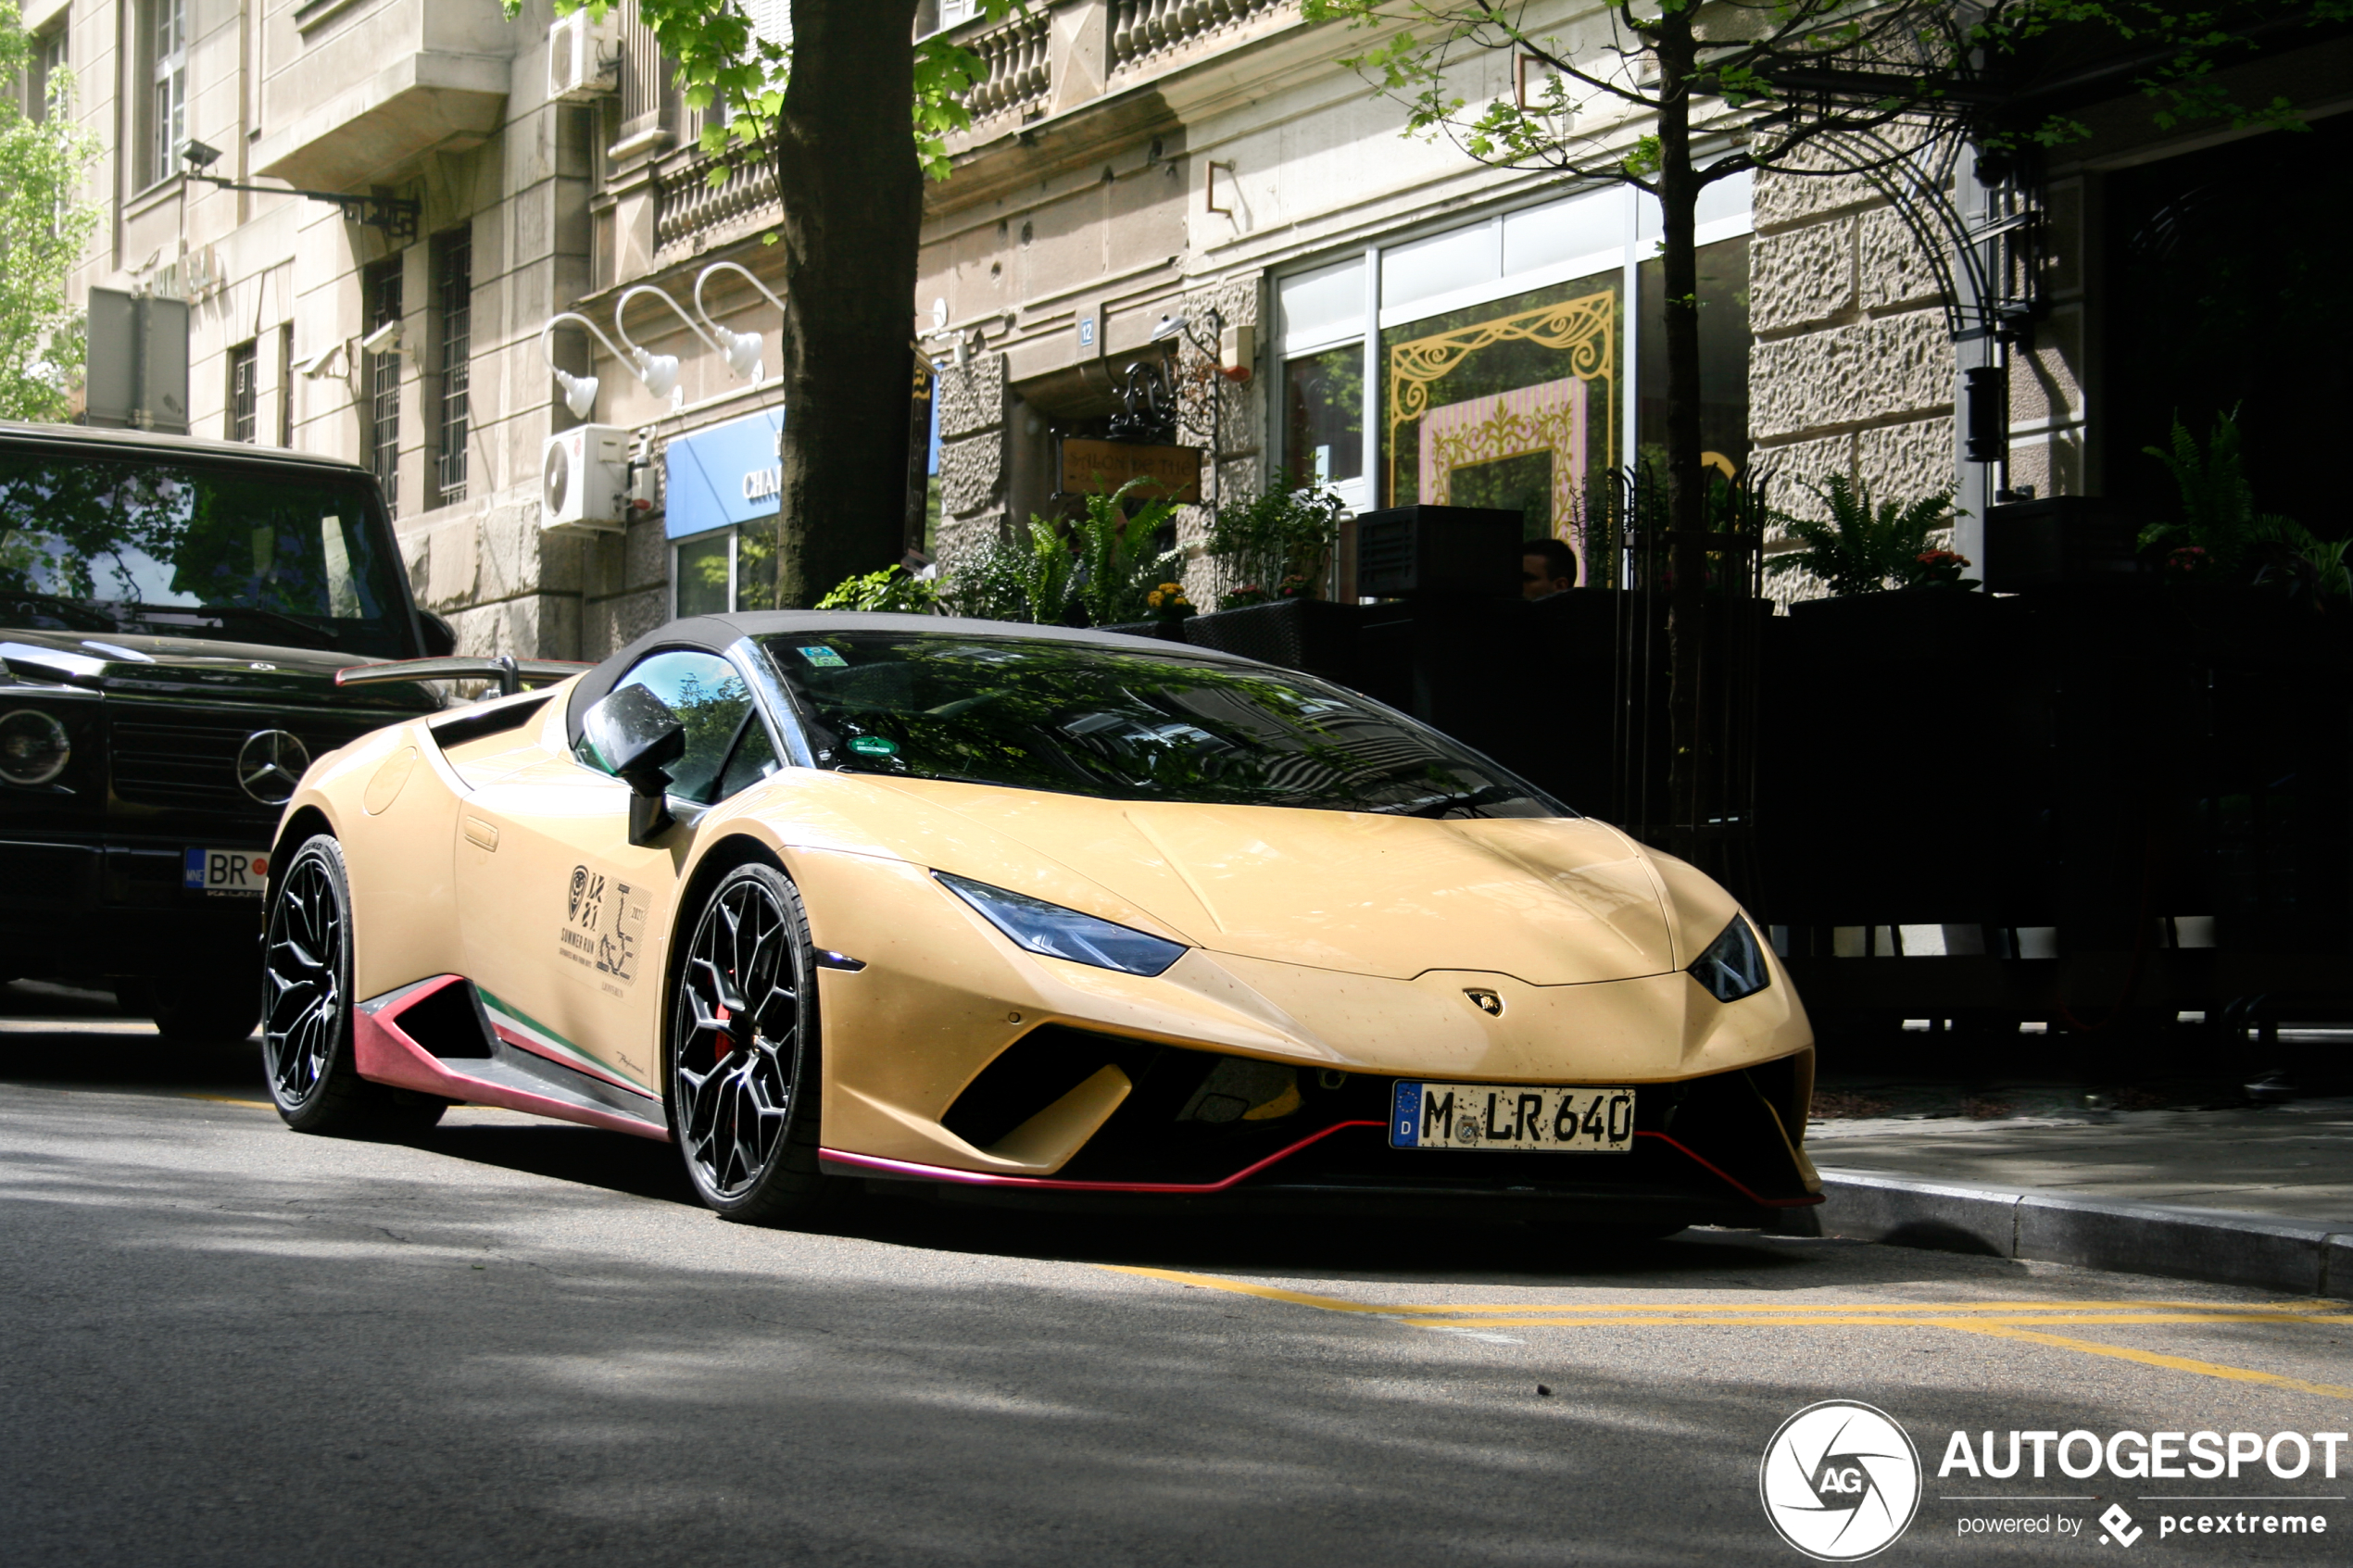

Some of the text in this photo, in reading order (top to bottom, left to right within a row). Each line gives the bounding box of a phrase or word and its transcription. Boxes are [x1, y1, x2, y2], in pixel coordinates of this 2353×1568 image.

[1082, 323, 1092, 340] 12
[186, 869, 205, 883] MNE
[209, 854, 248, 885] BR
[560, 927, 596, 955] SUMMER RUN
[1422, 1091, 1632, 1142] M LR 640
[1400, 1121, 1411, 1135] D
